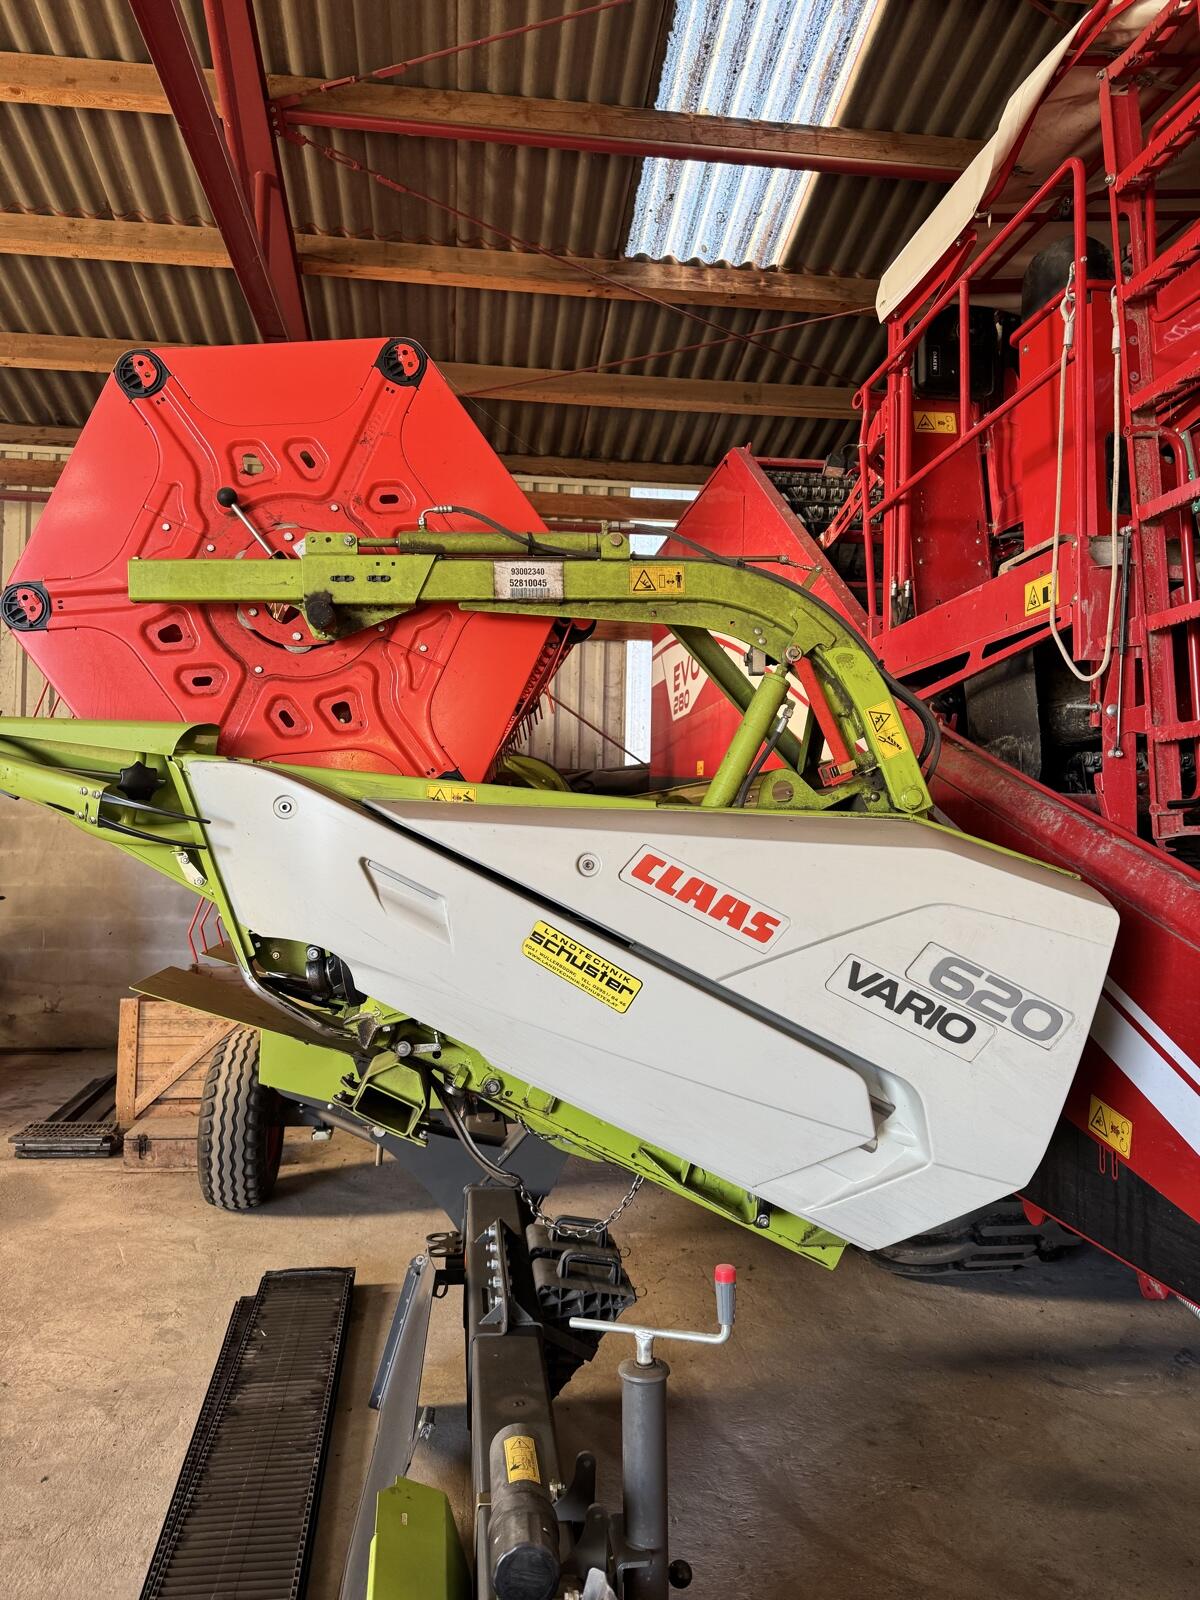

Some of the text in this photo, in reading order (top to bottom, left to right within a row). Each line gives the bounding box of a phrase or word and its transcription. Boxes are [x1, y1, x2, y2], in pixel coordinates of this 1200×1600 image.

[510, 579, 547, 587] 52810045
[511, 567, 545, 575] 93002340
[674, 656, 699, 692] EVO
[674, 689, 689, 715] 280
[631, 854, 781, 943] CLAAS
[544, 928, 631, 983] LANDTECHNIK
[848, 961, 976, 1044] VARIO
[929, 957, 1063, 1041] 620
